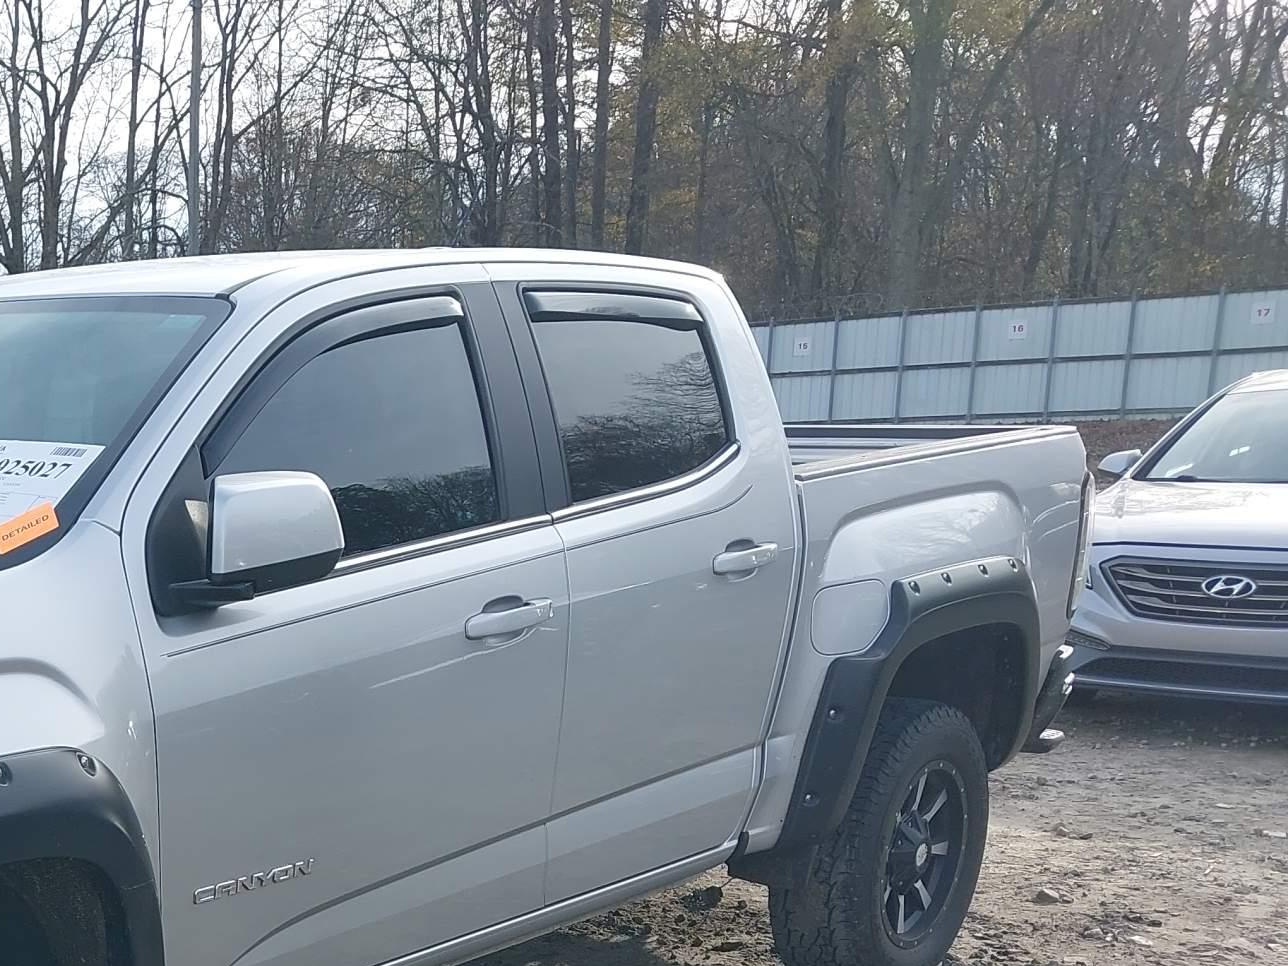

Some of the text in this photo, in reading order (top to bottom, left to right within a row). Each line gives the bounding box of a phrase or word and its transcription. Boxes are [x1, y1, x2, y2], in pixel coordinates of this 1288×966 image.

[1257, 308, 1271, 317] 17
[1, 514, 50, 542] DETAILED
[193, 858, 315, 904] CANYON
